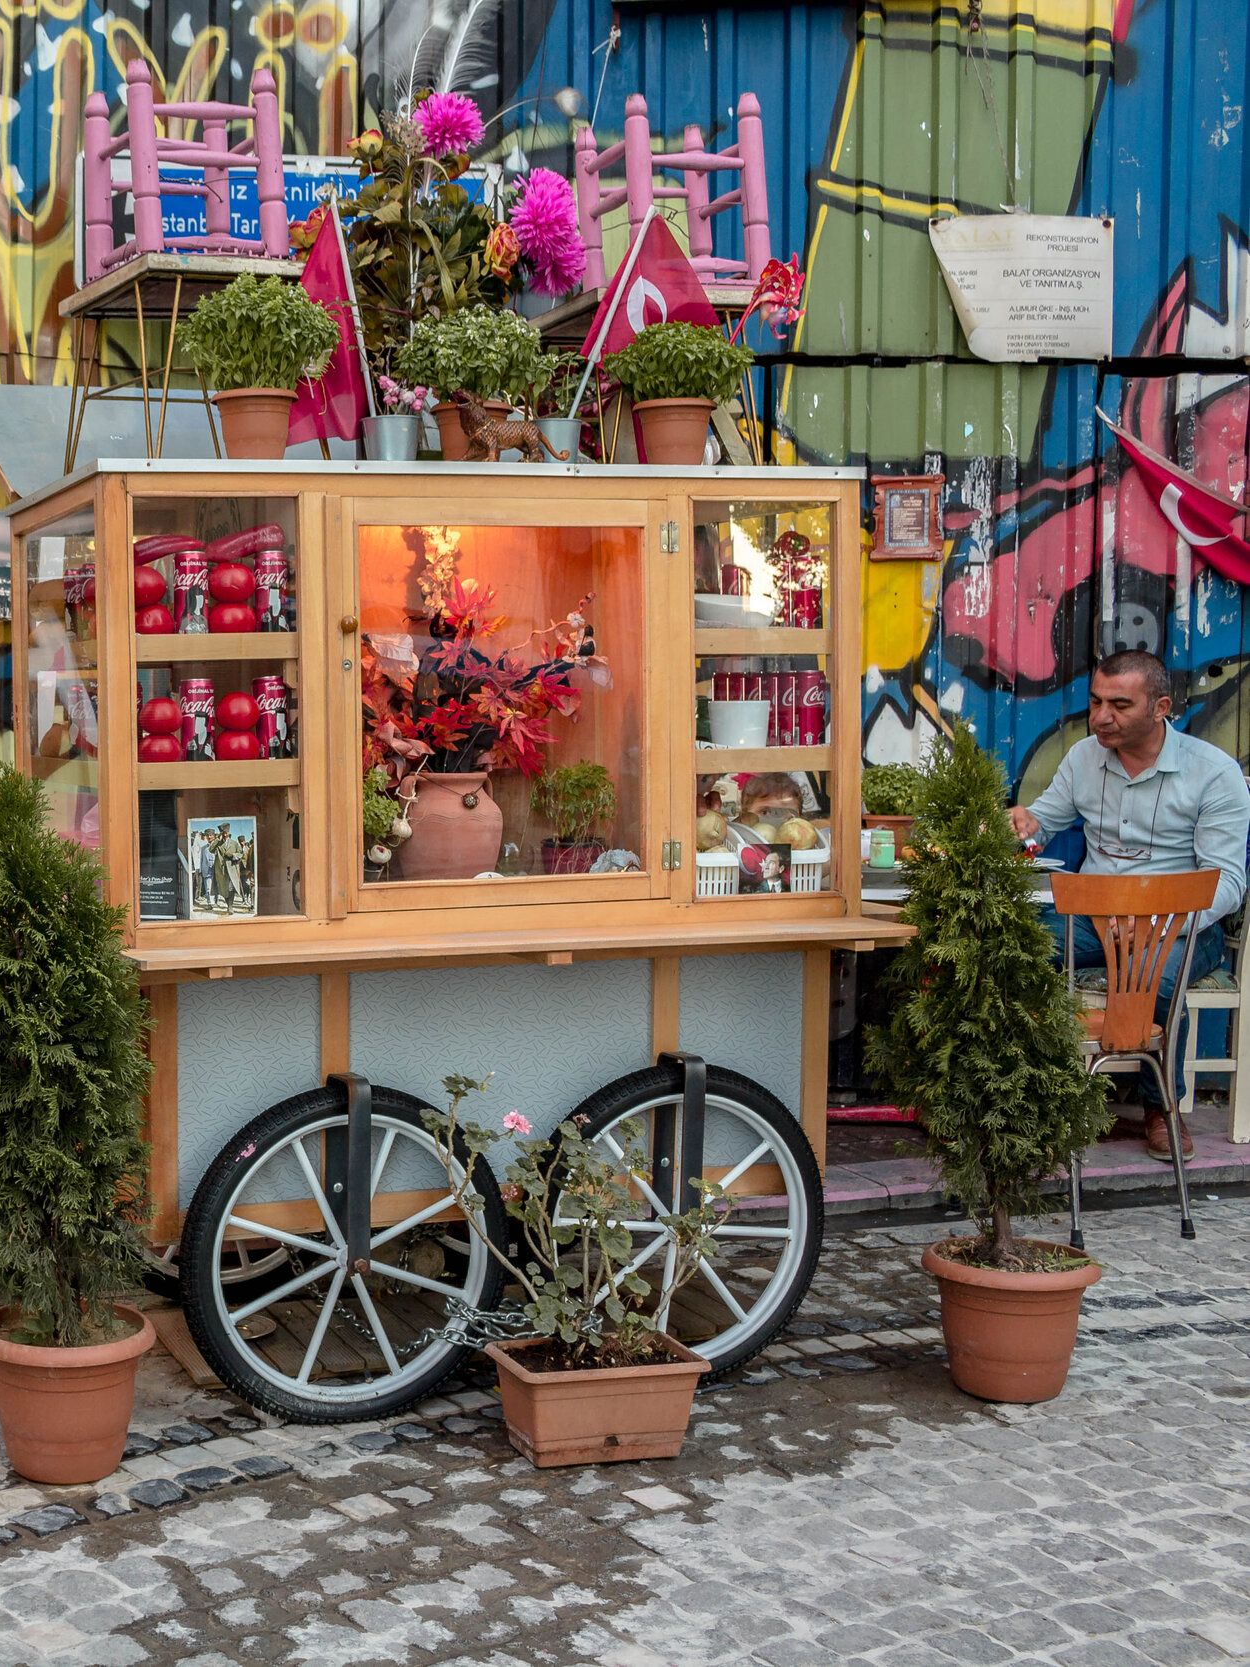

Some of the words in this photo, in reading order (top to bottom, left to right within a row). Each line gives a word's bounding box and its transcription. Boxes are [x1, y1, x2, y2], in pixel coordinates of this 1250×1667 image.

[1047, 243, 1079, 252] PROJESİ
[1002, 269, 1032, 278] BALAT
[1032, 268, 1101, 279] ORGANİZASYON
[1020, 280, 1033, 288] VE
